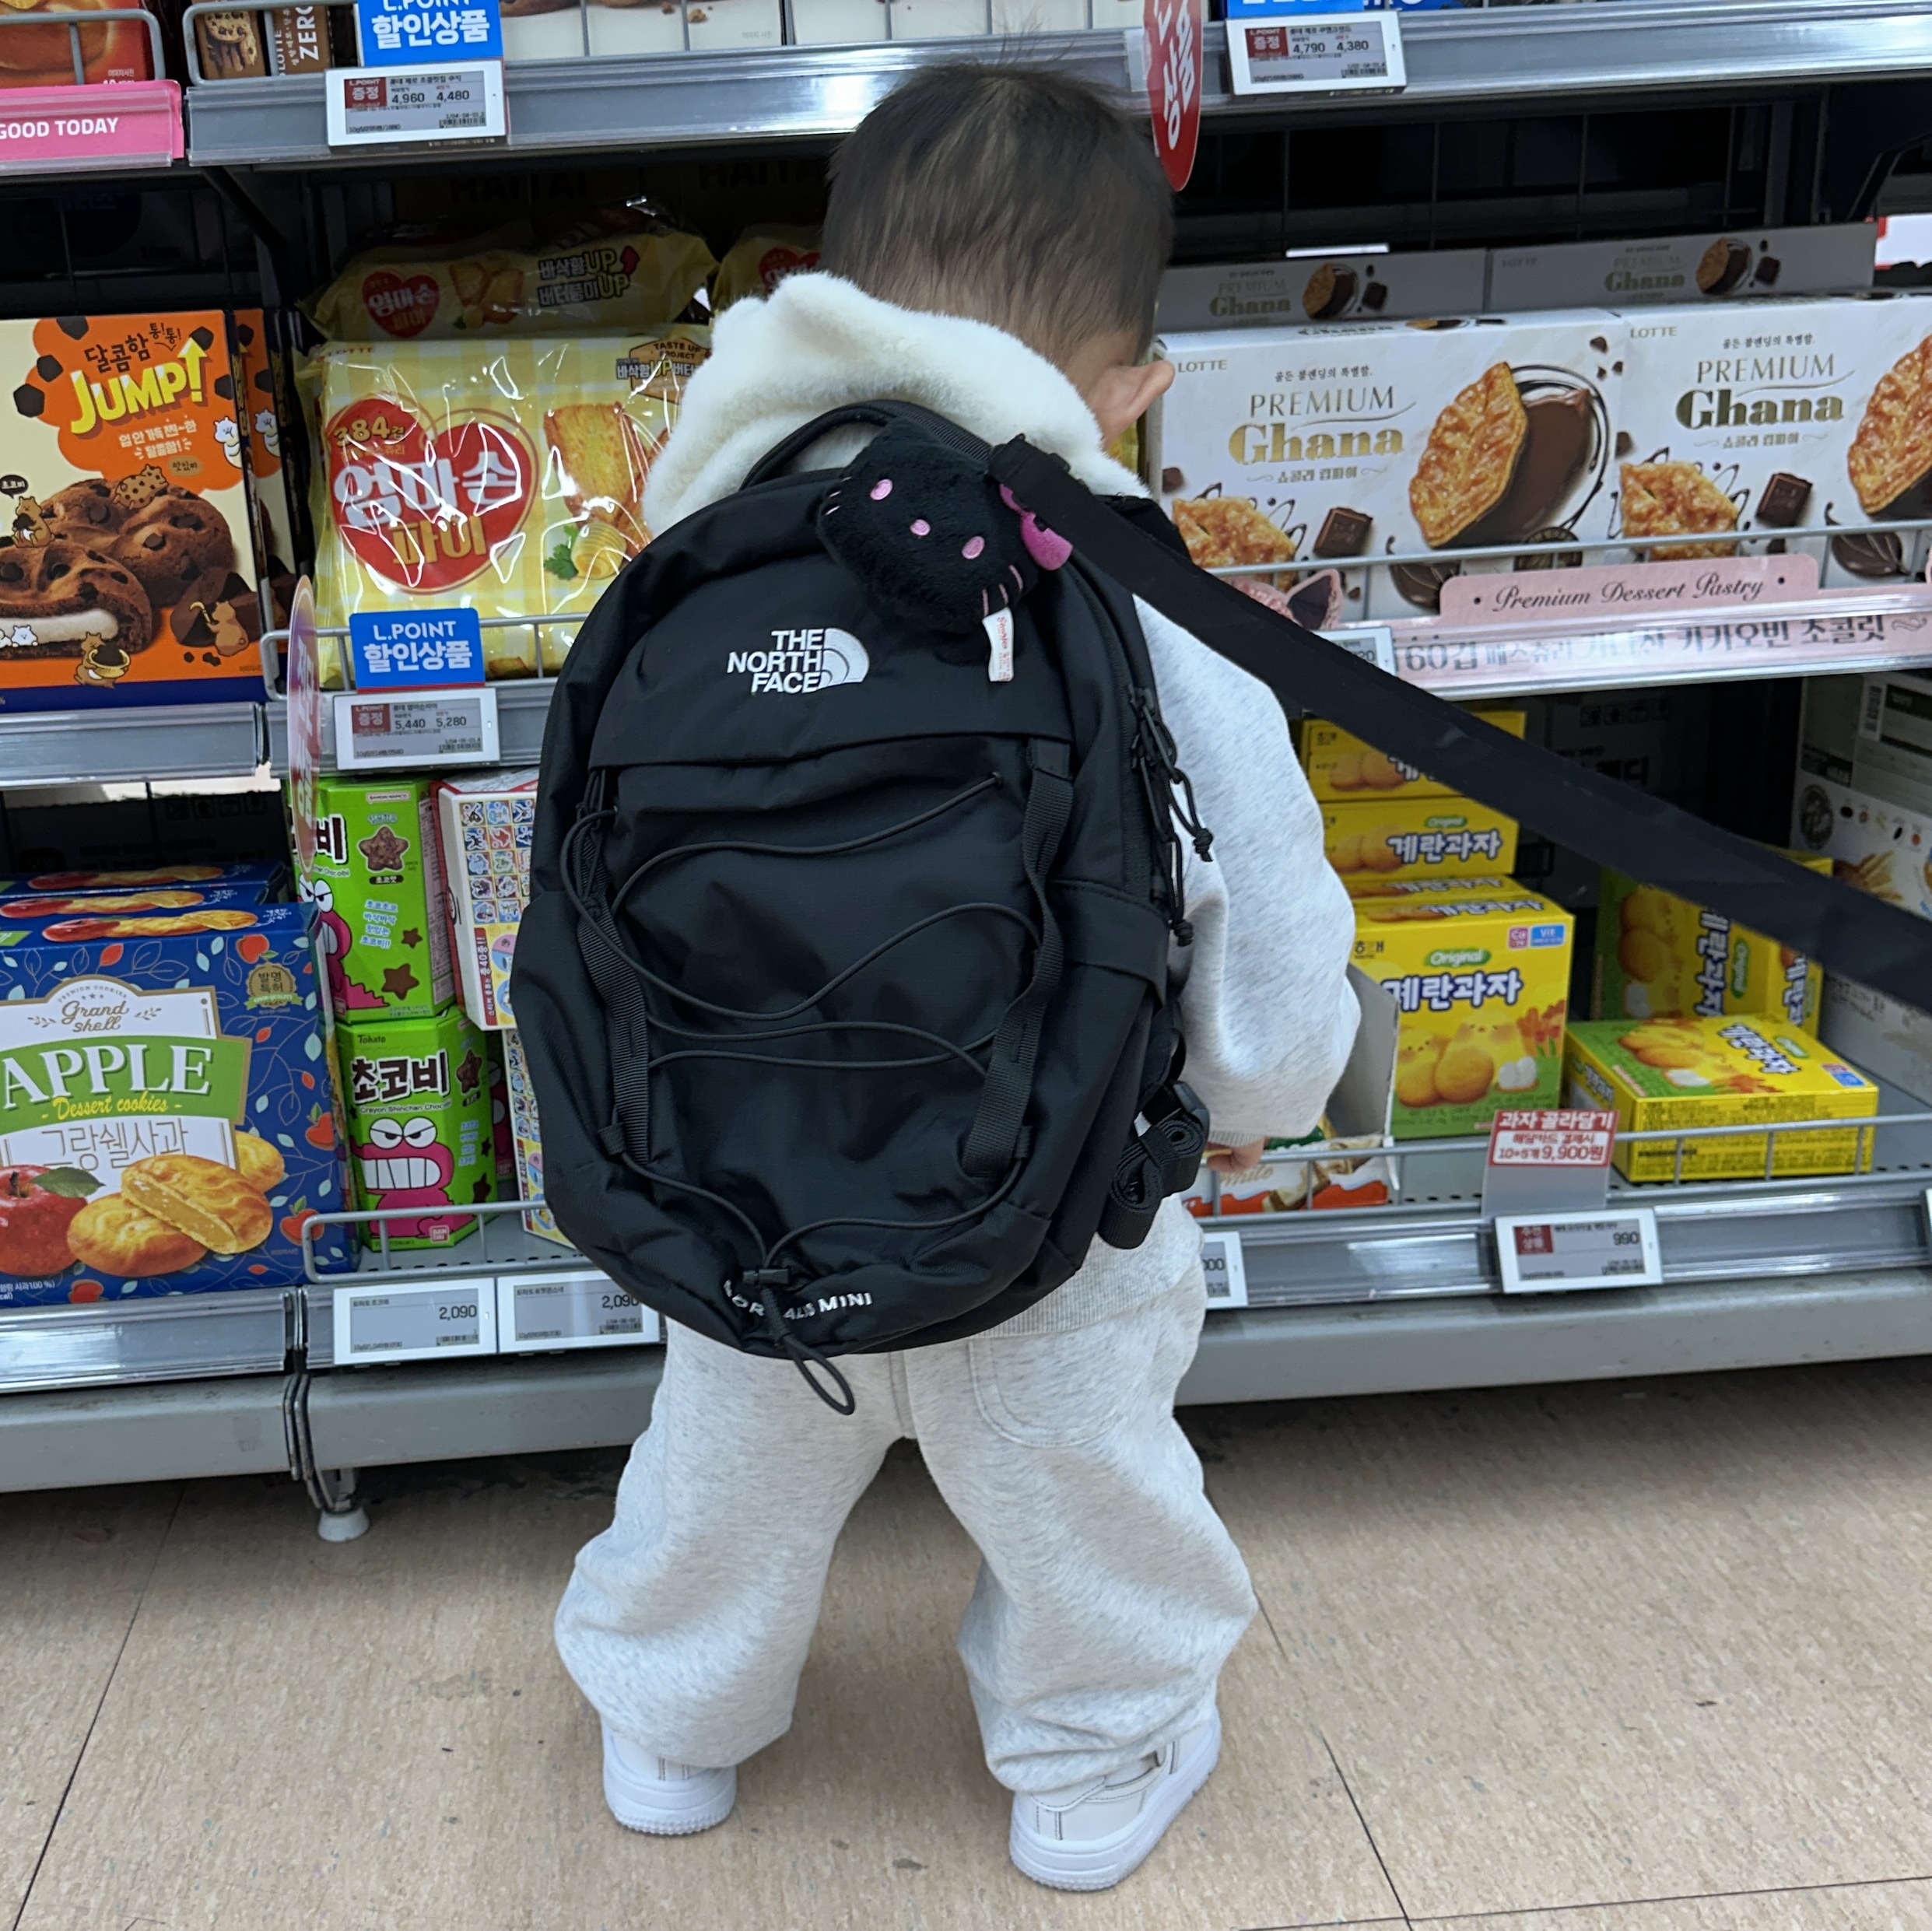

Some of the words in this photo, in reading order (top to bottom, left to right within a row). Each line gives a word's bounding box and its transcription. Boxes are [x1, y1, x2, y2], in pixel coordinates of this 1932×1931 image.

[371, 9, 490, 49] 할인상품
[1293, 43, 1326, 54] 4,790
[1337, 40, 1369, 52] 4,380
[352, 86, 380, 101] 증정
[391, 93, 425, 104] 4,960
[437, 90, 469, 102] 4,480
[0, 121, 50, 140] GOOD
[54, 117, 119, 136] TODAY
[538, 248, 617, 280] 바삭함UP
[1604, 272, 1685, 292] Ghana
[368, 282, 440, 314] 엄마손
[1209, 295, 1292, 317] Ghana
[1630, 326, 1677, 339] LOTTE
[84, 333, 151, 373] 달콤함
[1178, 360, 1228, 373] LOTTE
[1697, 354, 1834, 384] PREMIUM
[1250, 386, 1394, 419] PREMIUM
[1676, 388, 1843, 429] Ghana
[1228, 422, 1404, 465] Ghana
[334, 451, 517, 527] 엄마손
[389, 515, 487, 565] 파이
[1492, 585, 1591, 612] Premium
[1601, 581, 1686, 605] Dessert
[1692, 571, 1765, 601] Pastry
[373, 621, 457, 640] L.POINT
[772, 629, 825, 650] THE
[1395, 642, 1478, 671] 60겹
[1681, 620, 1790, 654] 카카오빈
[1800, 615, 1886, 644] 초콜릿
[363, 640, 473, 674] 할인상품
[727, 650, 822, 674] NORTH
[751, 671, 822, 694] FACE
[395, 719, 426, 731] 5,440
[436, 717, 467, 728] 5,280
[1387, 828, 1502, 864] 계란과자
[1430, 949, 1485, 967] Original
[58, 985, 91, 1003] PREMIUM
[1380, 968, 1524, 1011] 계란과자
[61, 1000, 130, 1025] Grand
[72, 1015, 121, 1032] shell
[2, 1044, 213, 1111] APPLE
[351, 1049, 451, 1104] 초코비
[53, 1095, 113, 1120] Dessert
[117, 1090, 168, 1113] cookies
[1499, 1111, 1538, 1129] 과자
[1541, 1111, 1615, 1130] 골라담기
[41, 1117, 188, 1172] 그랑쉘사과
[1542, 1144, 1604, 1162] 9,900원
[1613, 1232, 1639, 1246] 990
[439, 1305, 477, 1321] 2,090
[601, 1294, 639, 1310] 2,090
[818, 1291, 873, 1312] MINI
